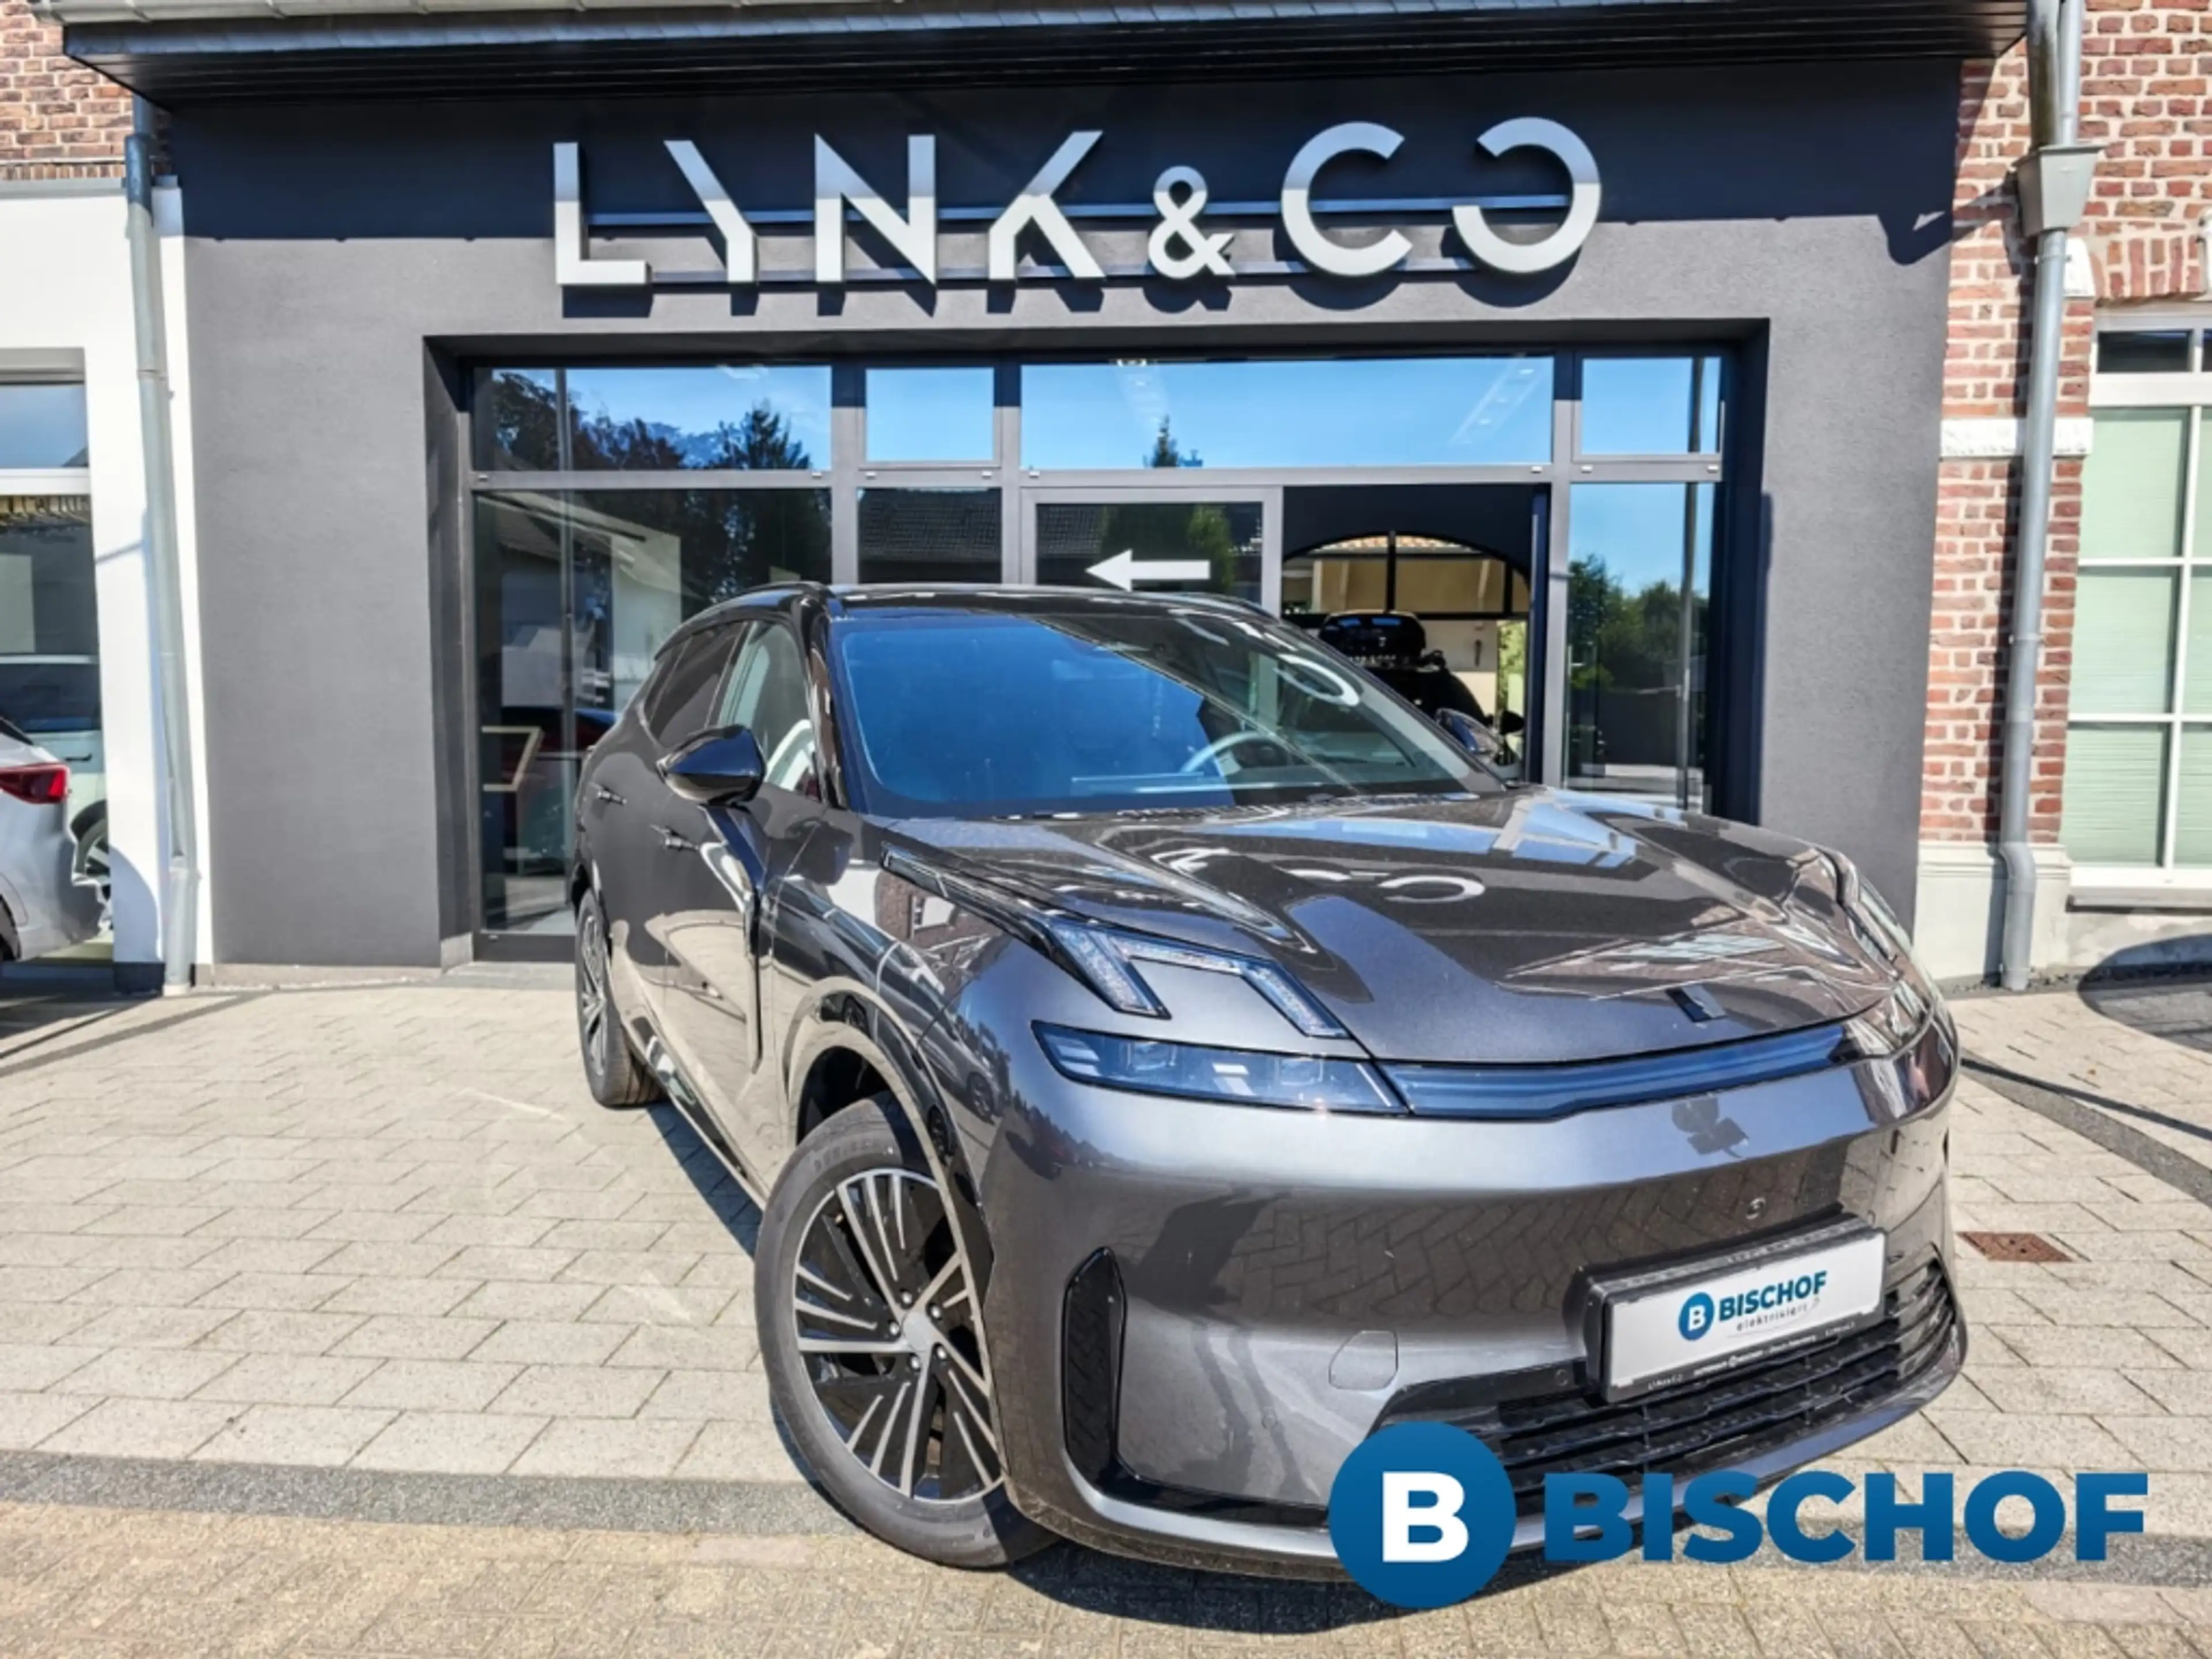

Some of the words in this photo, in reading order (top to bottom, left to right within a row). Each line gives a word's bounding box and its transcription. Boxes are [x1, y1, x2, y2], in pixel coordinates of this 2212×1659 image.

[553, 131, 1106, 286] LYNK
[1147, 165, 1235, 279] &
[1719, 1270, 1827, 1322] BISCHOF
